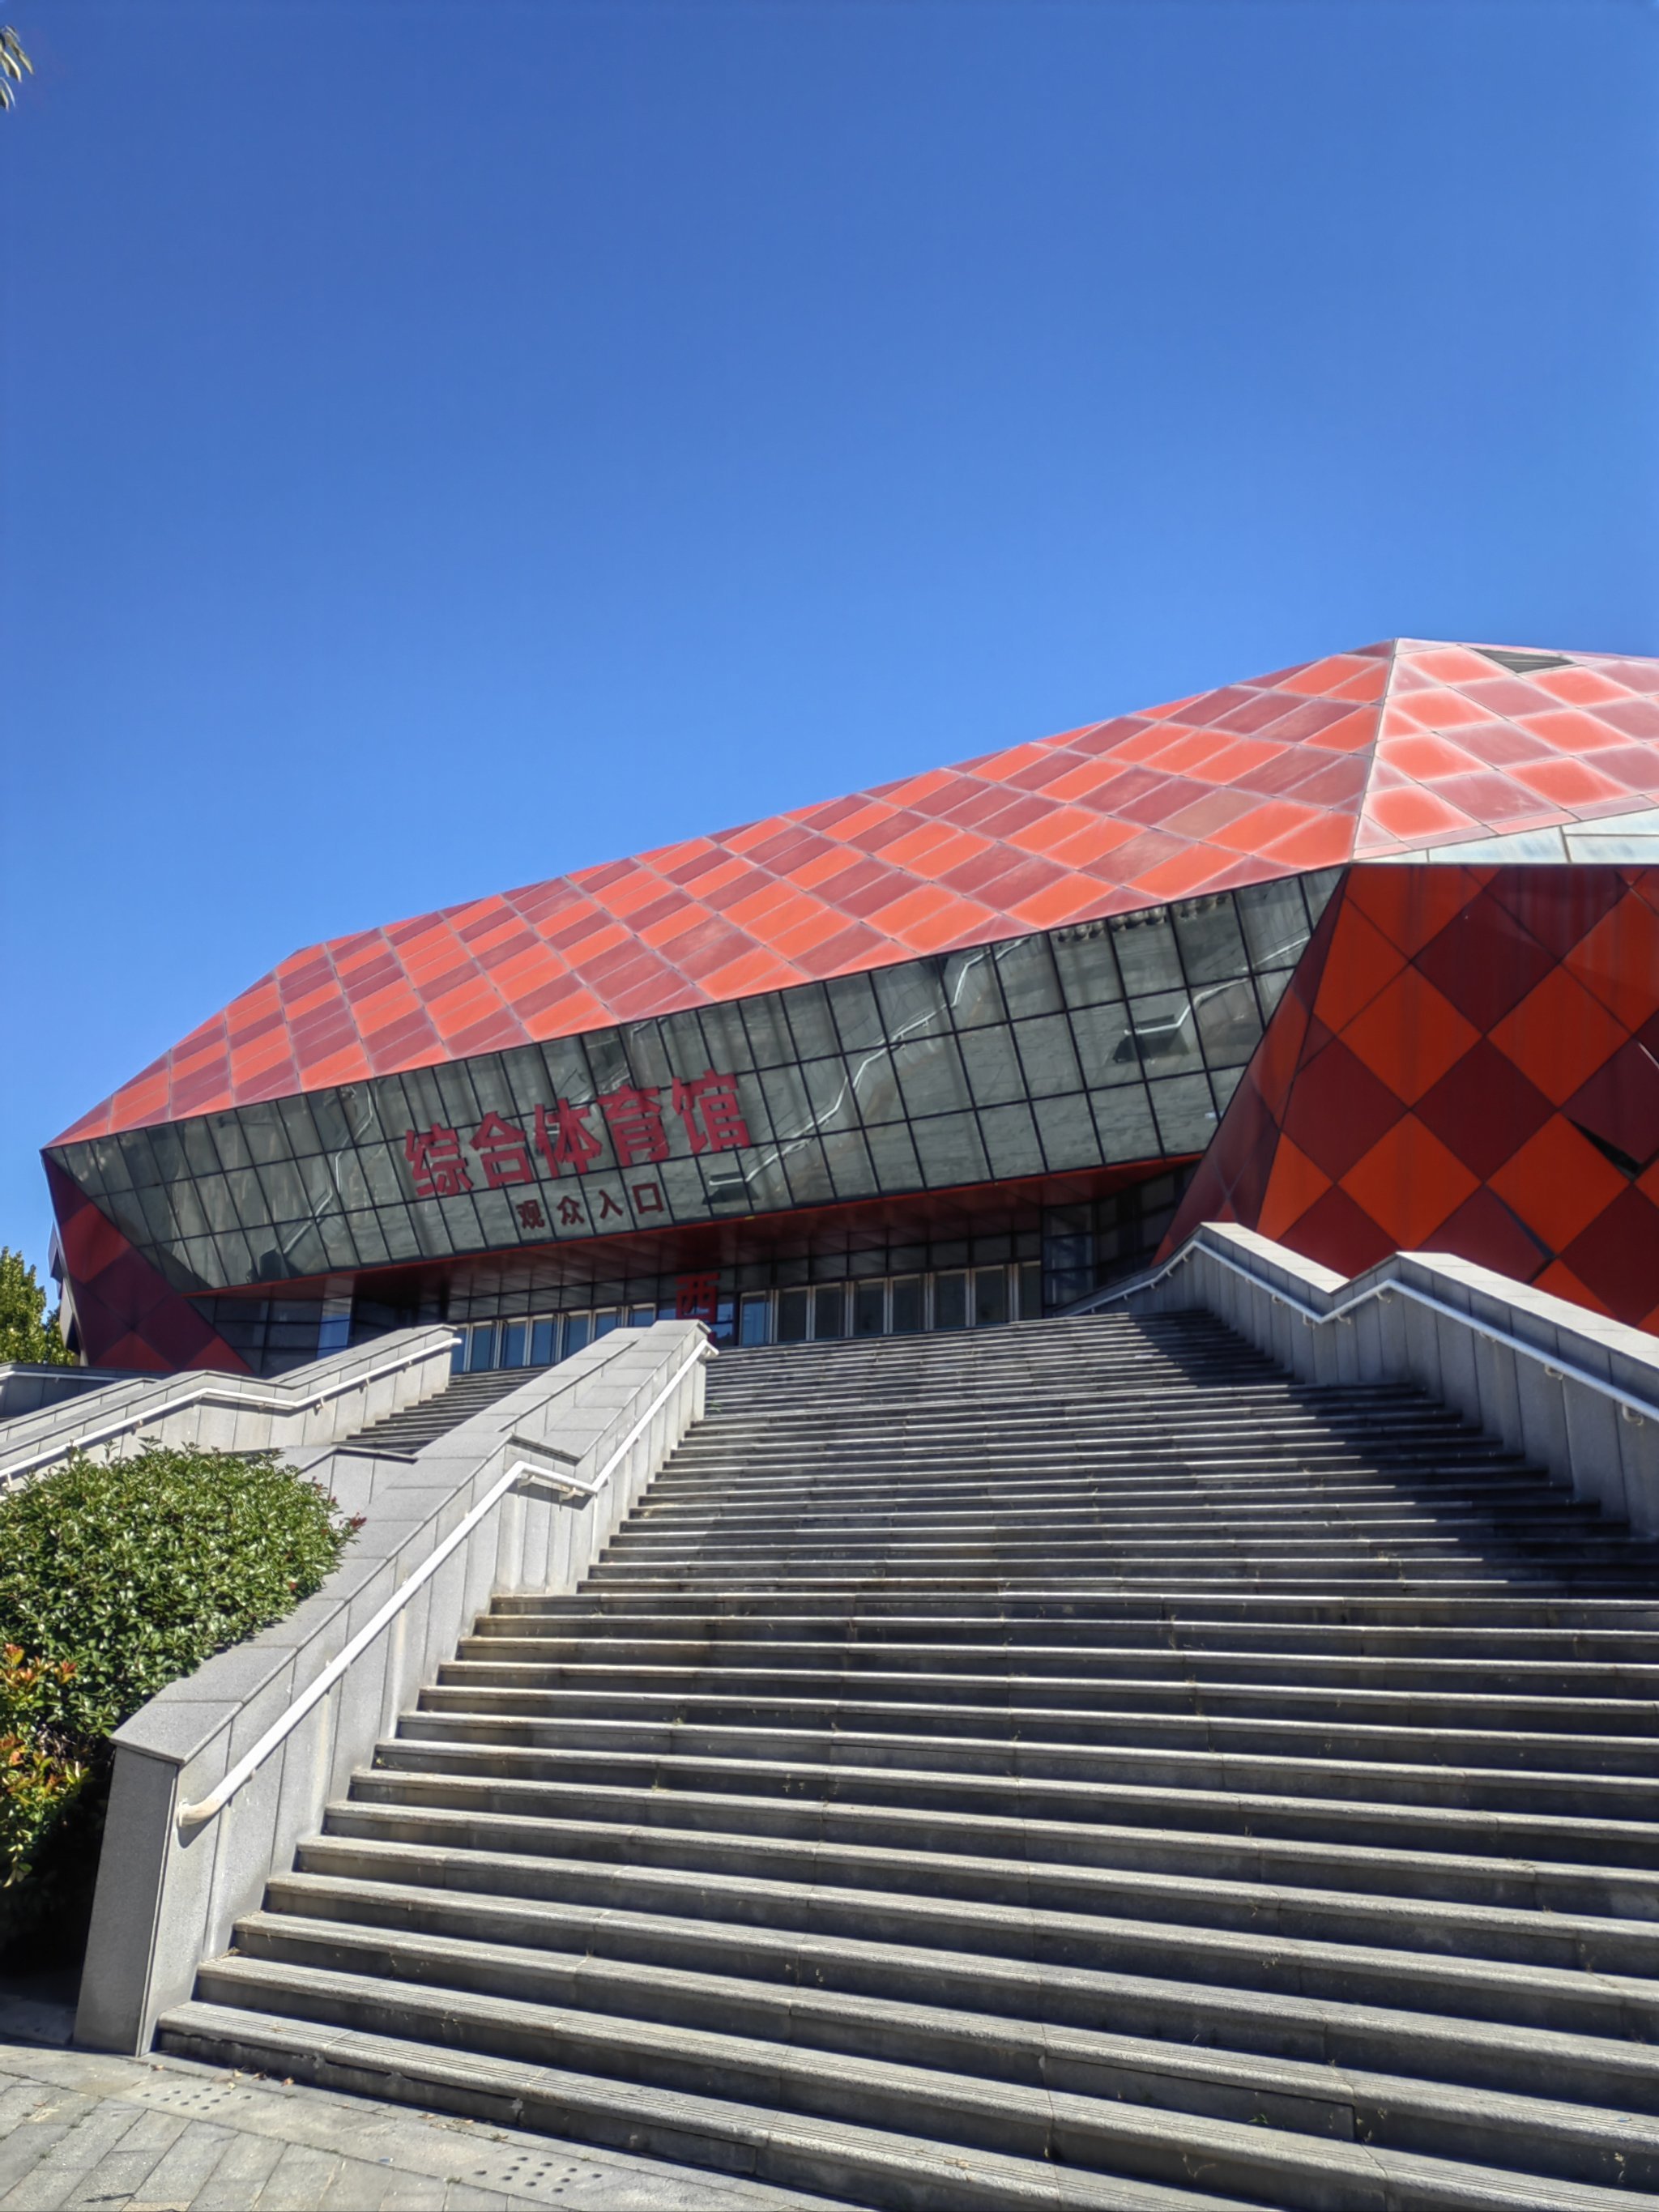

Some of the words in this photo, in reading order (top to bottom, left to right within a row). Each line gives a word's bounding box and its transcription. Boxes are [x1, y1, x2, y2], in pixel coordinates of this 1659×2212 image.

[405, 1068, 751, 1197] 综合体育馆
[516, 1182, 664, 1230] 观众入口
[676, 1272, 720, 1346] 西
